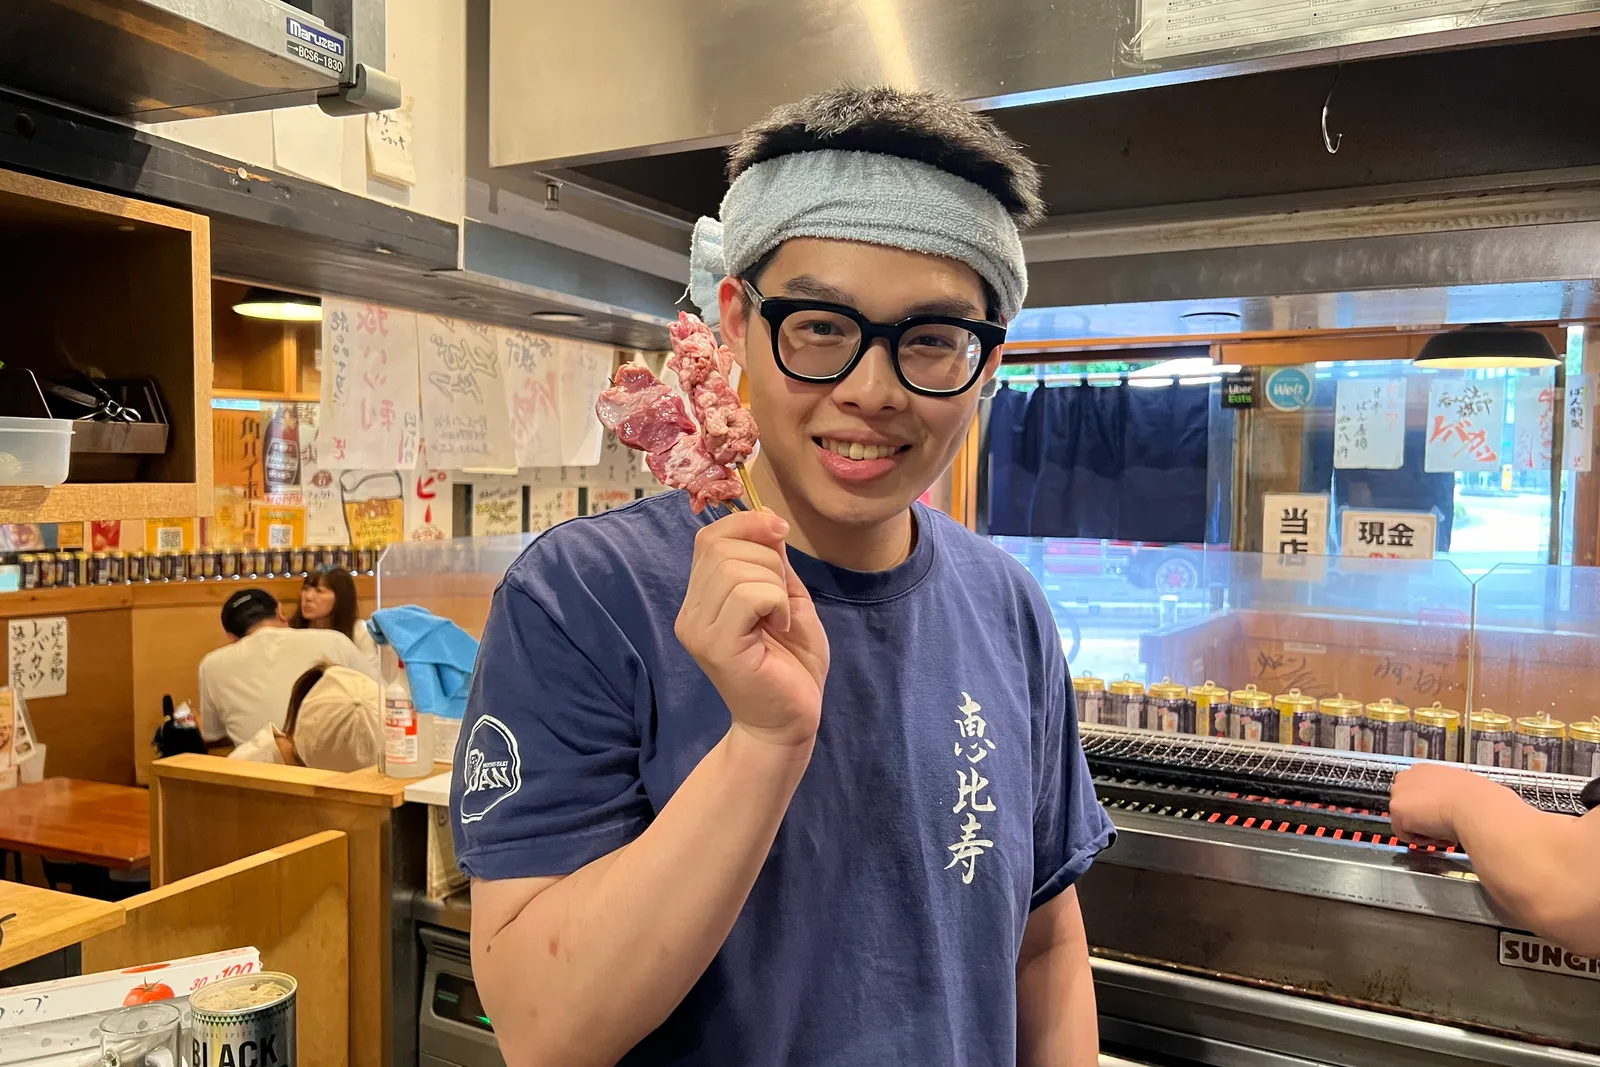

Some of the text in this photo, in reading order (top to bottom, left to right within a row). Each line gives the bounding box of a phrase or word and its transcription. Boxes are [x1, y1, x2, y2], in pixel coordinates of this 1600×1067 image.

[290, 19, 341, 54] Maruzen
[298, 45, 343, 72] BCS6-1830
[1228, 384, 1252, 395] Uber
[1228, 394, 1252, 404] Eats
[240, 416, 260, 530] 角ハイボール
[1358, 521, 1415, 547] 現金
[943, 691, 997, 885] 恵比寿
[189, 976, 208, 991] 30
[0, 994, 48, 1019] ップ
[192, 1034, 278, 1067] BLACK
